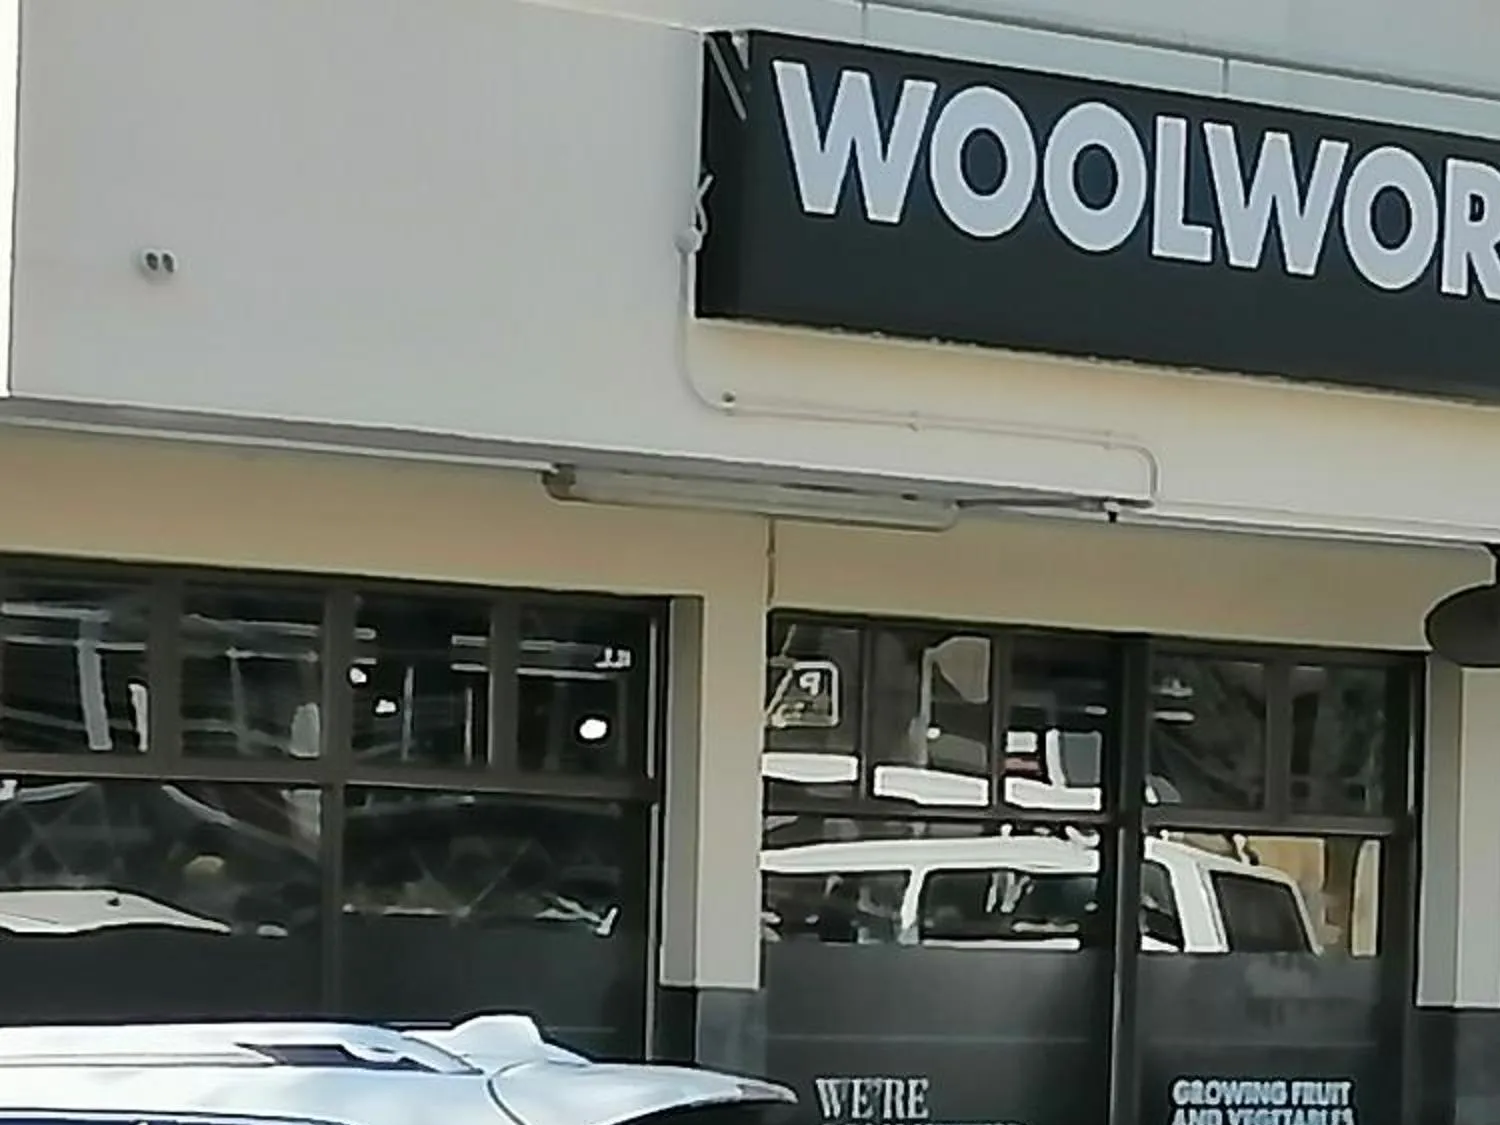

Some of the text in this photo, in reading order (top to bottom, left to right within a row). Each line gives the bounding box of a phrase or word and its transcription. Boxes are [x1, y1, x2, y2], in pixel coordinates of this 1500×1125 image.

[815, 1078, 929, 1119] WE'RE
[1172, 1079, 1352, 1106] GROWING FRUIT
